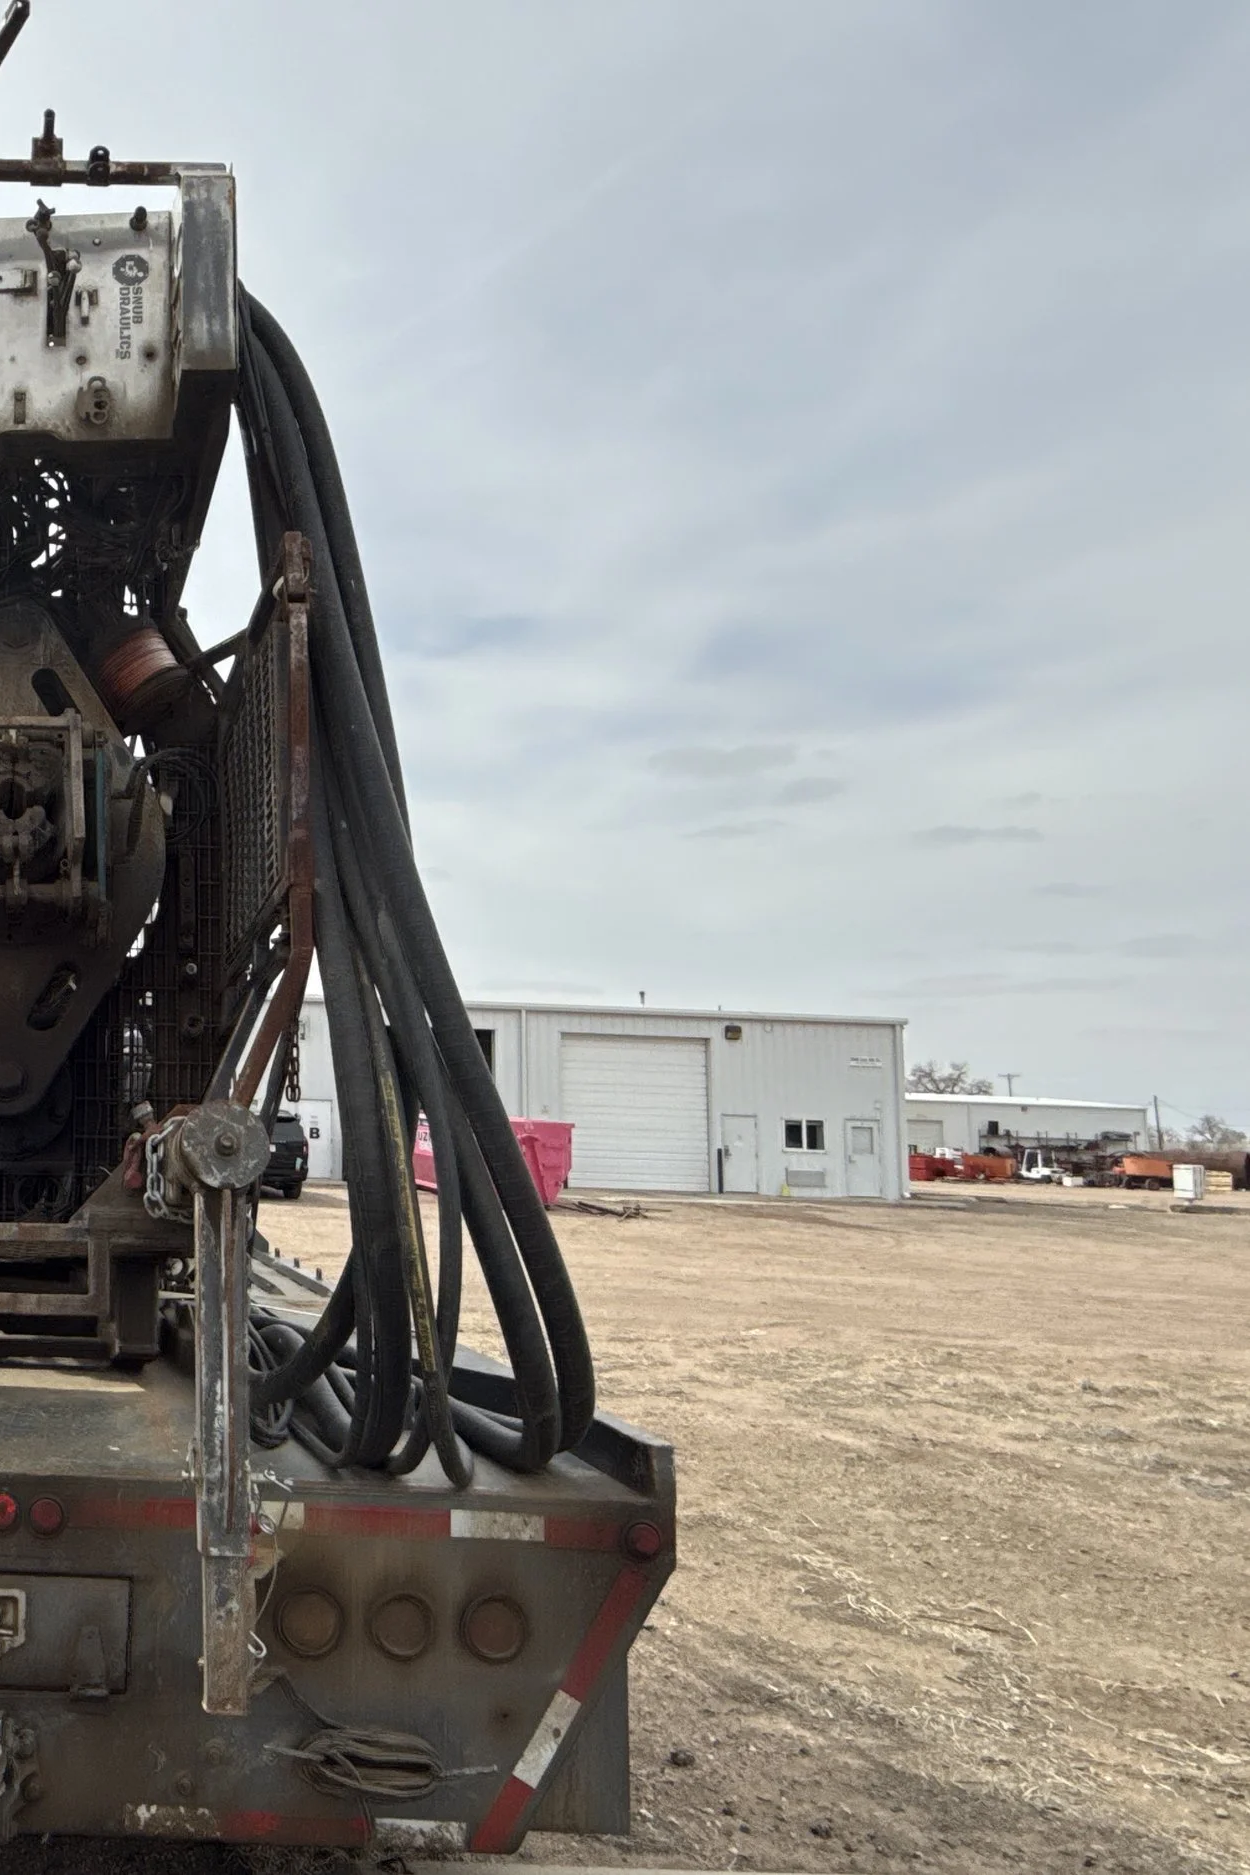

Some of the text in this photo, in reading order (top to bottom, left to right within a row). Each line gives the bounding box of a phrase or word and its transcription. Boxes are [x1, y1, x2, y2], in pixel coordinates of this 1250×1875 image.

[119, 286, 131, 360] DRAULICS
[132, 286, 143, 325] SNUB
[309, 1127, 320, 1139] B
